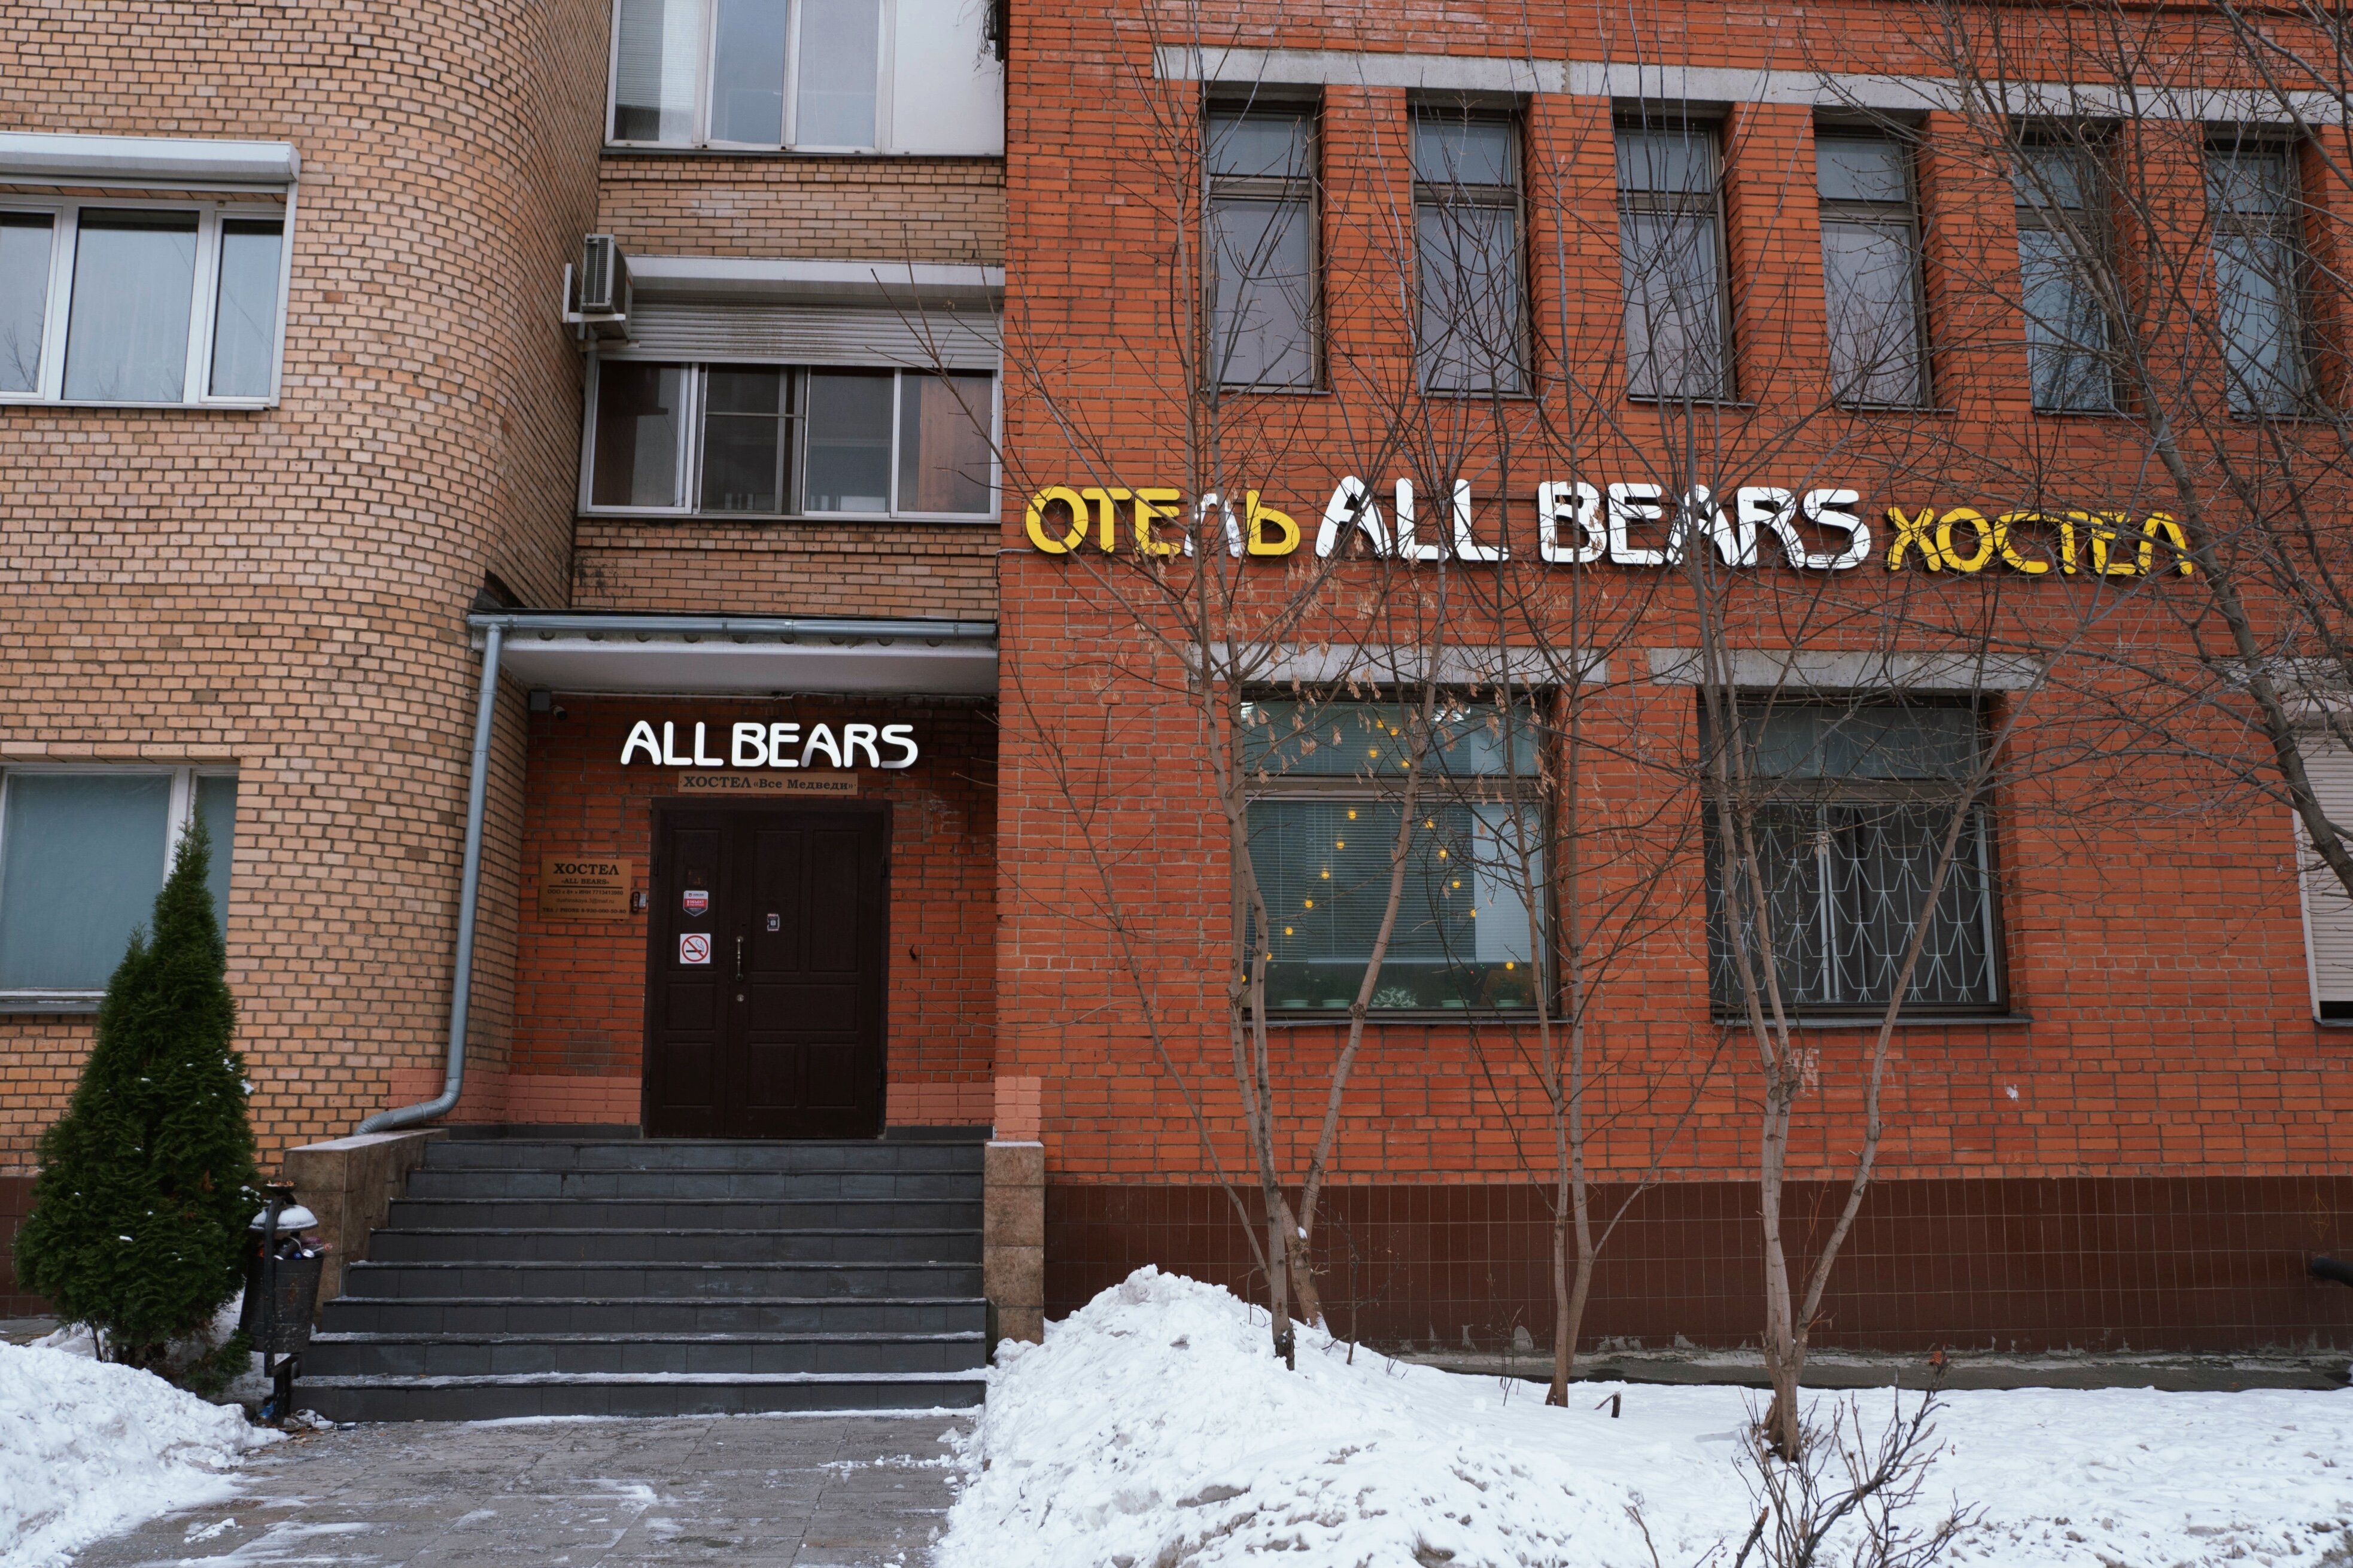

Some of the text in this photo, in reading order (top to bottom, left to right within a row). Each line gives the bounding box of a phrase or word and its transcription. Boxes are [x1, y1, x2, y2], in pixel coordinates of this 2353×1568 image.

[1026, 486, 1300, 557] ОТЕЛЬ
[1316, 475, 1871, 570] ALL BEARS
[1886, 507, 2192, 575] ХОСТЕЛ
[620, 720, 919, 768] ALL BEARS
[683, 776, 853, 790] ХОСТЕЛ «Все Медведи»
[553, 863, 619, 875] ХОСТЕЛ
